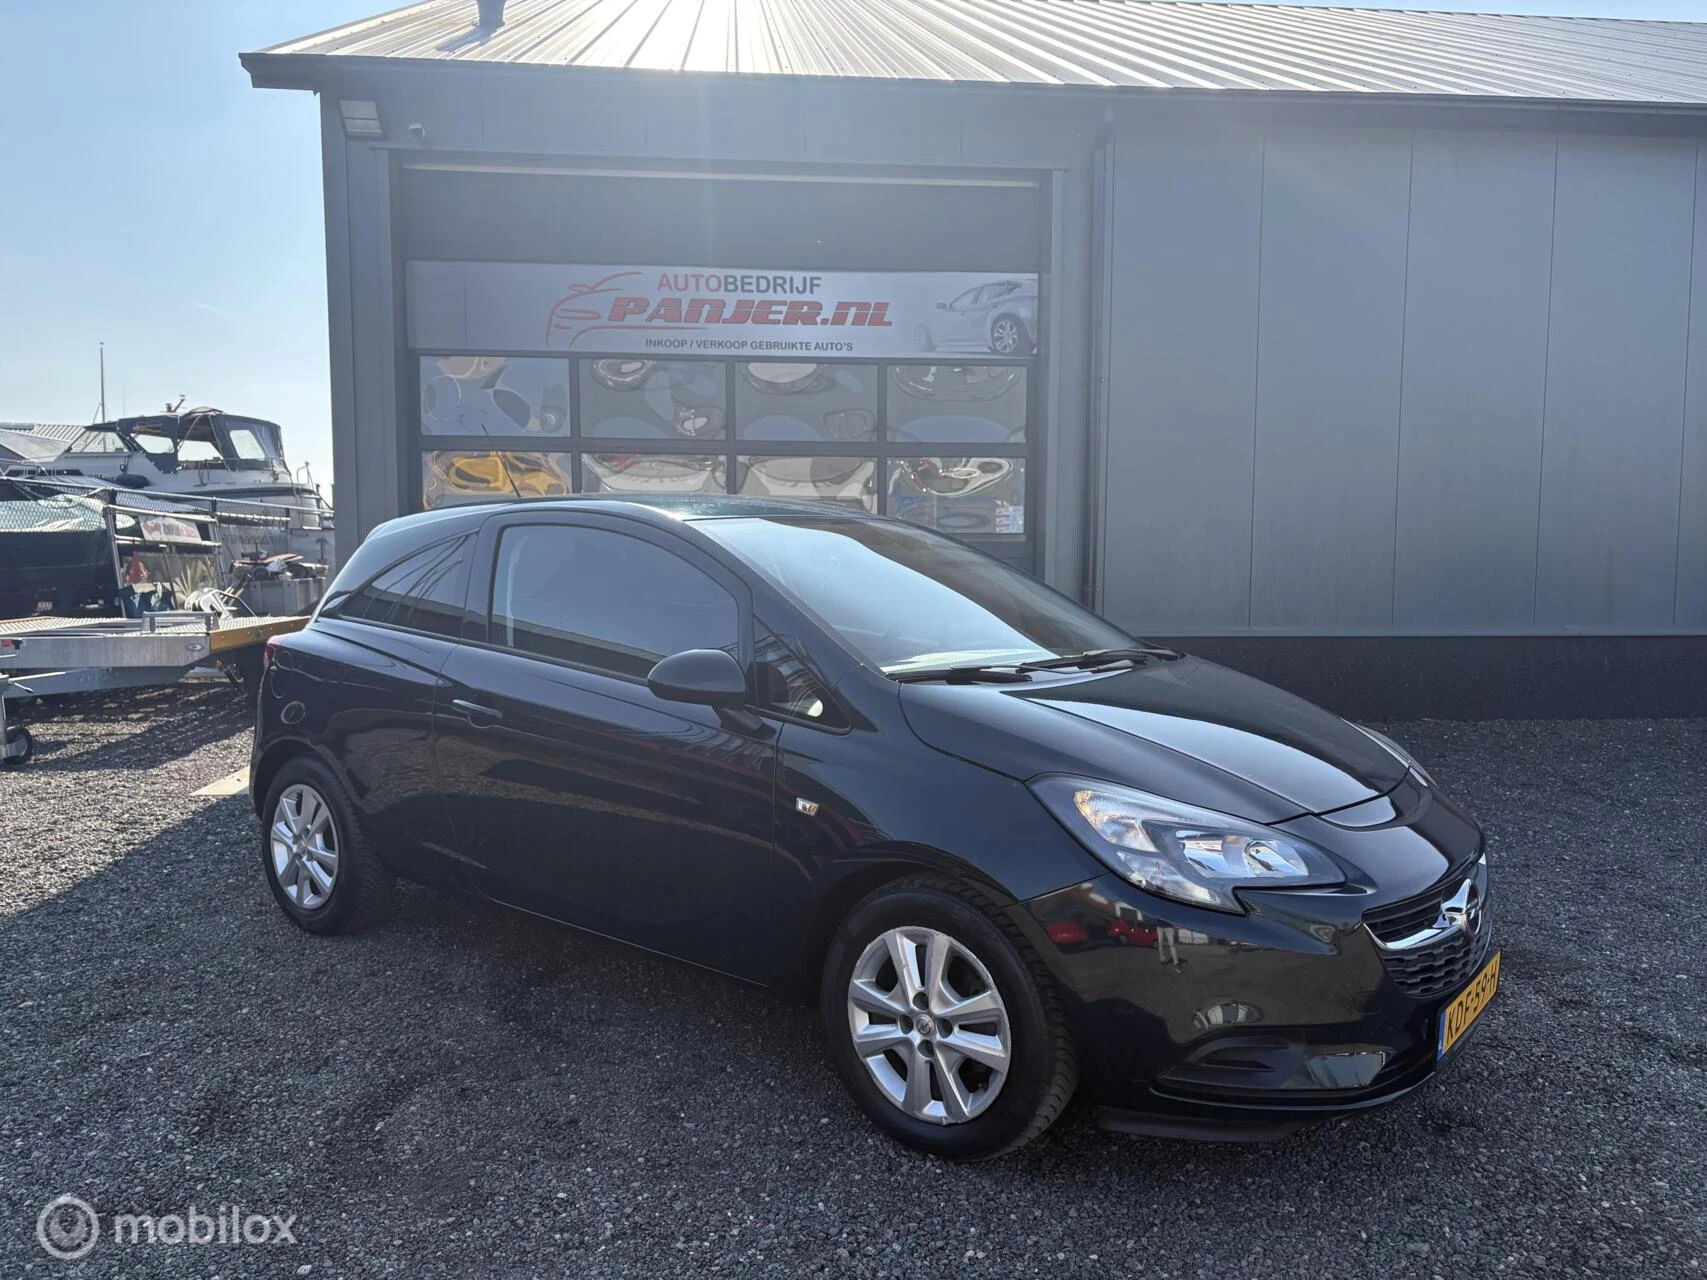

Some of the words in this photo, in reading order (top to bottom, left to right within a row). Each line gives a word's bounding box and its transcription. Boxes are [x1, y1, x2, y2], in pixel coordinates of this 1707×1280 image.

[657, 272, 822, 295] AUTOBEDRIJF
[645, 338, 687, 349] INKOOP
[695, 339, 748, 350] VERKOOP
[750, 340, 811, 351] GEBRUIKTE
[814, 341, 853, 351] AUTO'S
[1446, 961, 1498, 1045] KDF-59-H
